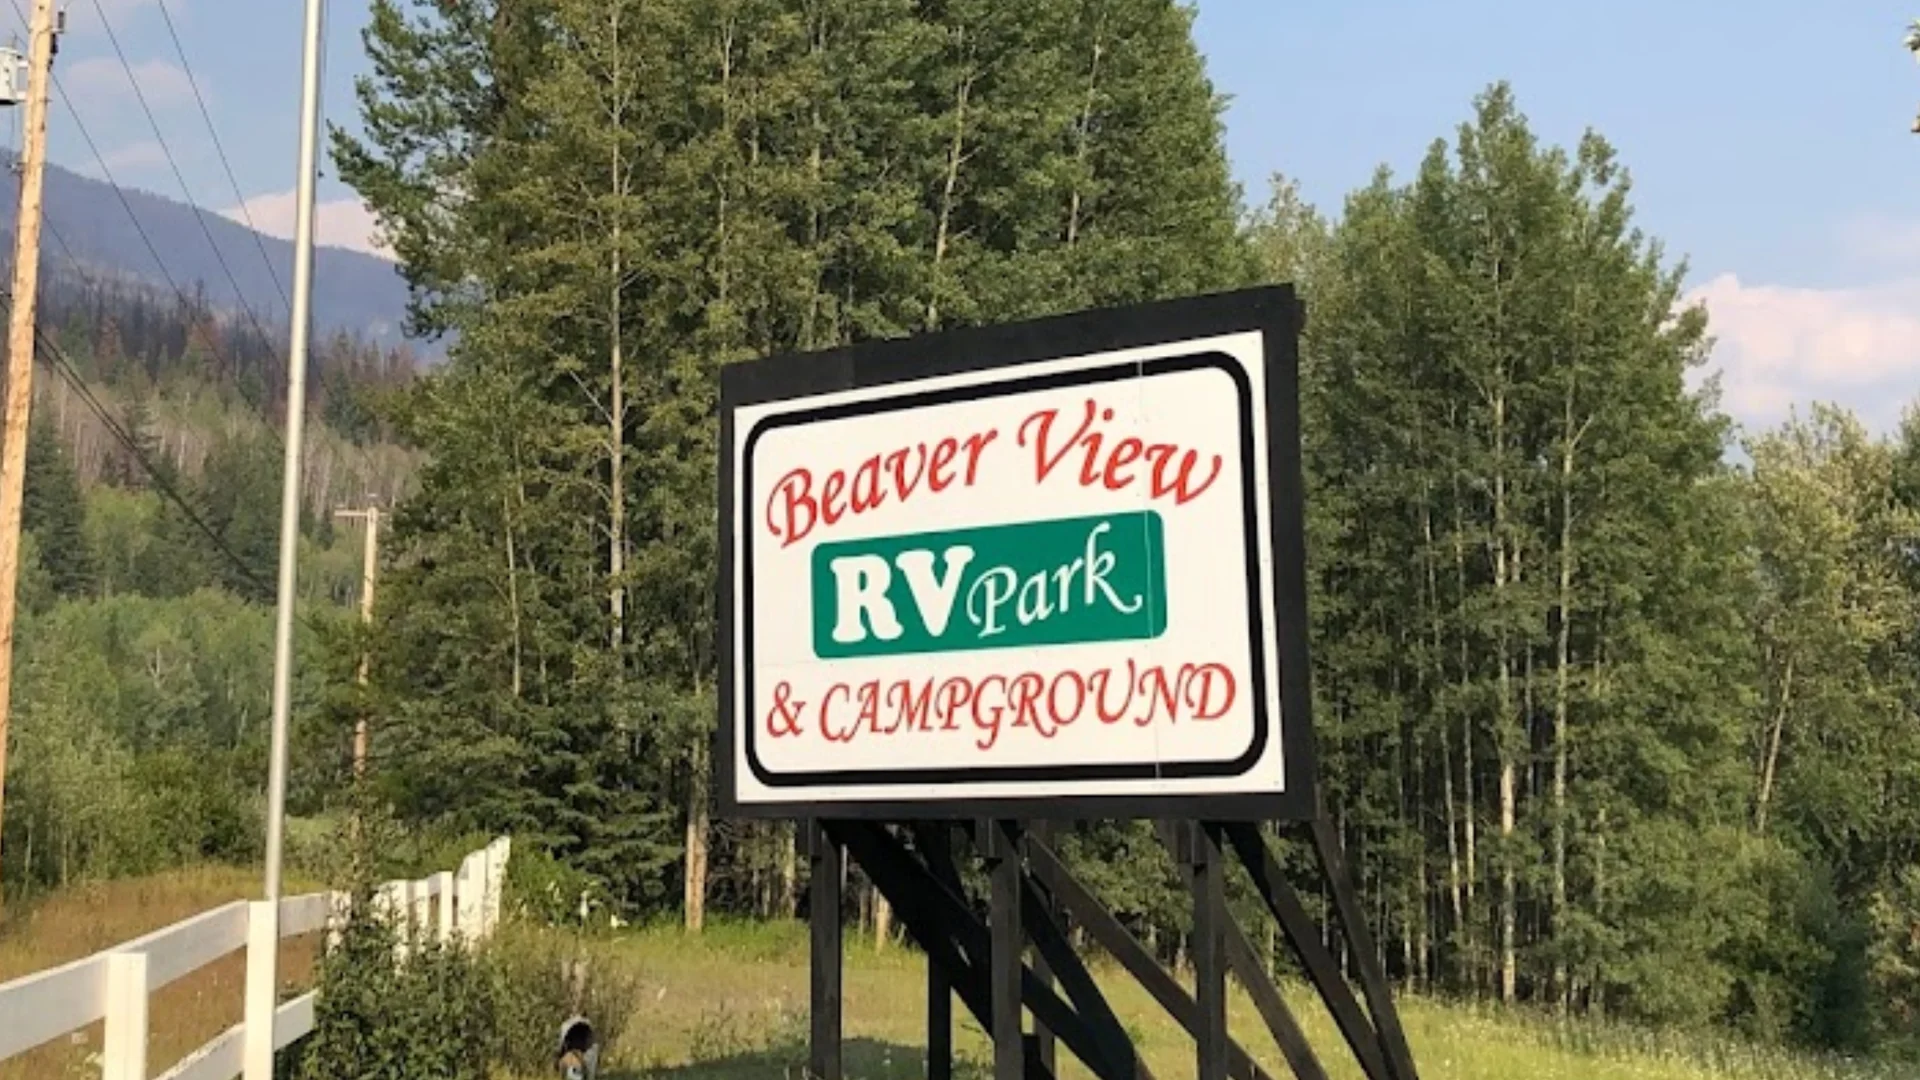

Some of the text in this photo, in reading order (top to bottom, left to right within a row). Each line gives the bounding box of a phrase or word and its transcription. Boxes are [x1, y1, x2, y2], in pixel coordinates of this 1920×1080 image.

[766, 398, 1222, 548] Beaver View
[830, 521, 1143, 643] RV Park
[766, 658, 1237, 751] & CAMPGROUND
